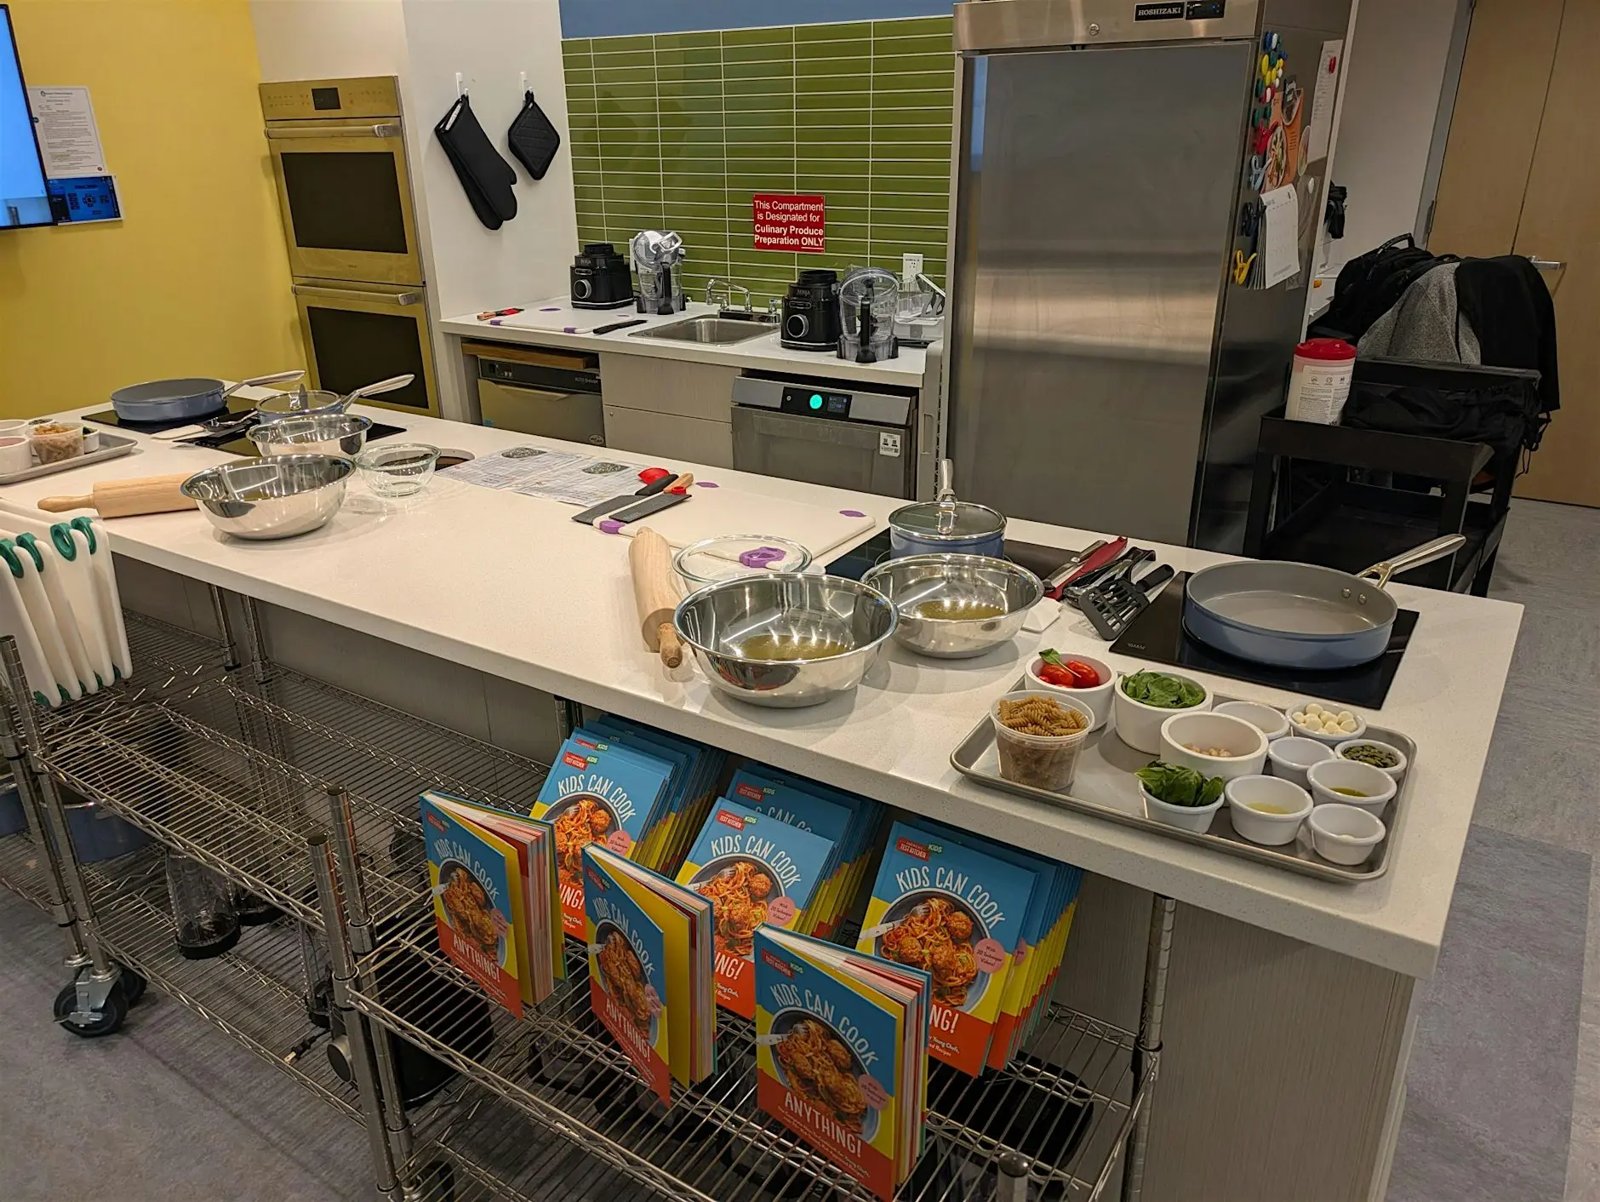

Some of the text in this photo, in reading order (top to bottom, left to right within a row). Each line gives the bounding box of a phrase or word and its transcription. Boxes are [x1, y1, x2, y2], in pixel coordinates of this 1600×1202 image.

[1138, 7, 1182, 16] HOSHIZAKI
[754, 200, 824, 212] This Compartment
[757, 211, 820, 223] is Designated for
[754, 223, 824, 236] Culinary Produce
[754, 234, 824, 247] Preparation ONLY
[587, 755, 598, 763] KIDS
[558, 774, 636, 822] KIDS CAN COOK
[763, 787, 775, 795] KIDS
[744, 816, 757, 824] KIDS
[711, 834, 801, 889] KIDS CAN COOK
[928, 844, 943, 853] KIDS
[433, 838, 500, 900] KIDS CAN COOK
[896, 866, 1005, 929] KIDS CAN COOK
[592, 897, 611, 919] KIDS
[611, 903, 629, 934] CAN
[631, 929, 656, 976] COOK
[453, 933, 500, 983] ANYTHING!
[606, 998, 651, 1062] ANYTHING!
[770, 983, 879, 1066] KIDS CAN COOK
[785, 1091, 862, 1158] ANYTHING!
